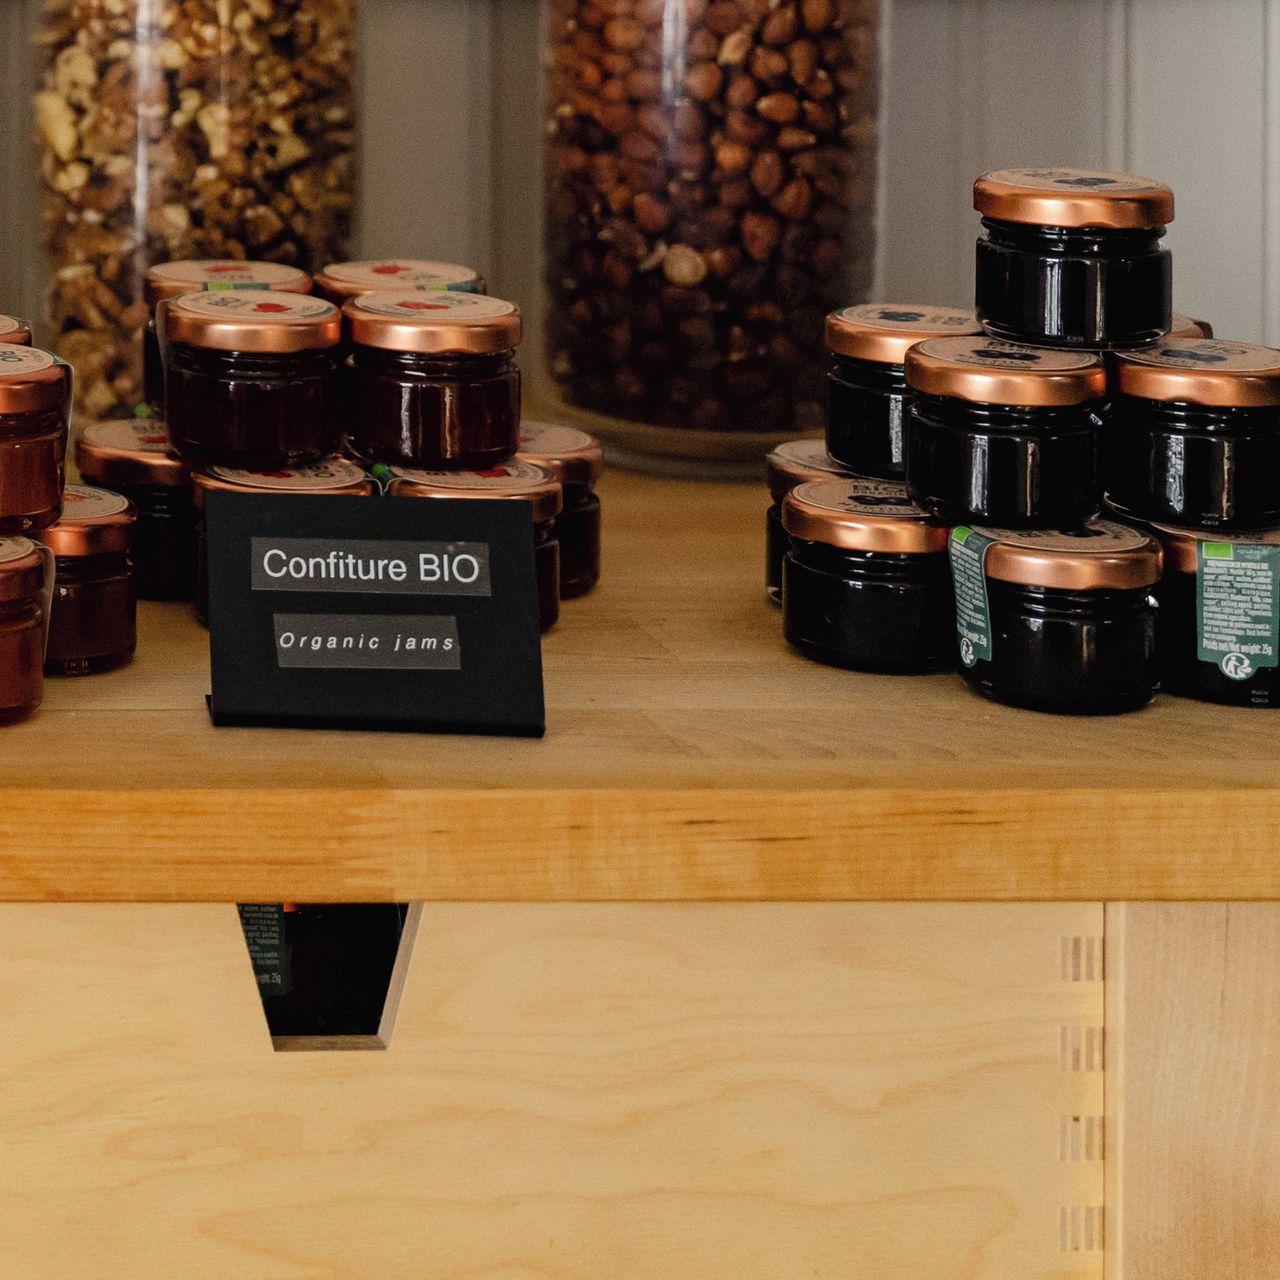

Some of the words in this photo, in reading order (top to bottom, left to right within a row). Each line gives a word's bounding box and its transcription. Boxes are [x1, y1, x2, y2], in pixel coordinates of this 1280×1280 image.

[263, 548, 407, 582] Confiture
[419, 553, 480, 583] BIO
[279, 632, 380, 650] Organic
[394, 634, 454, 651] jams
